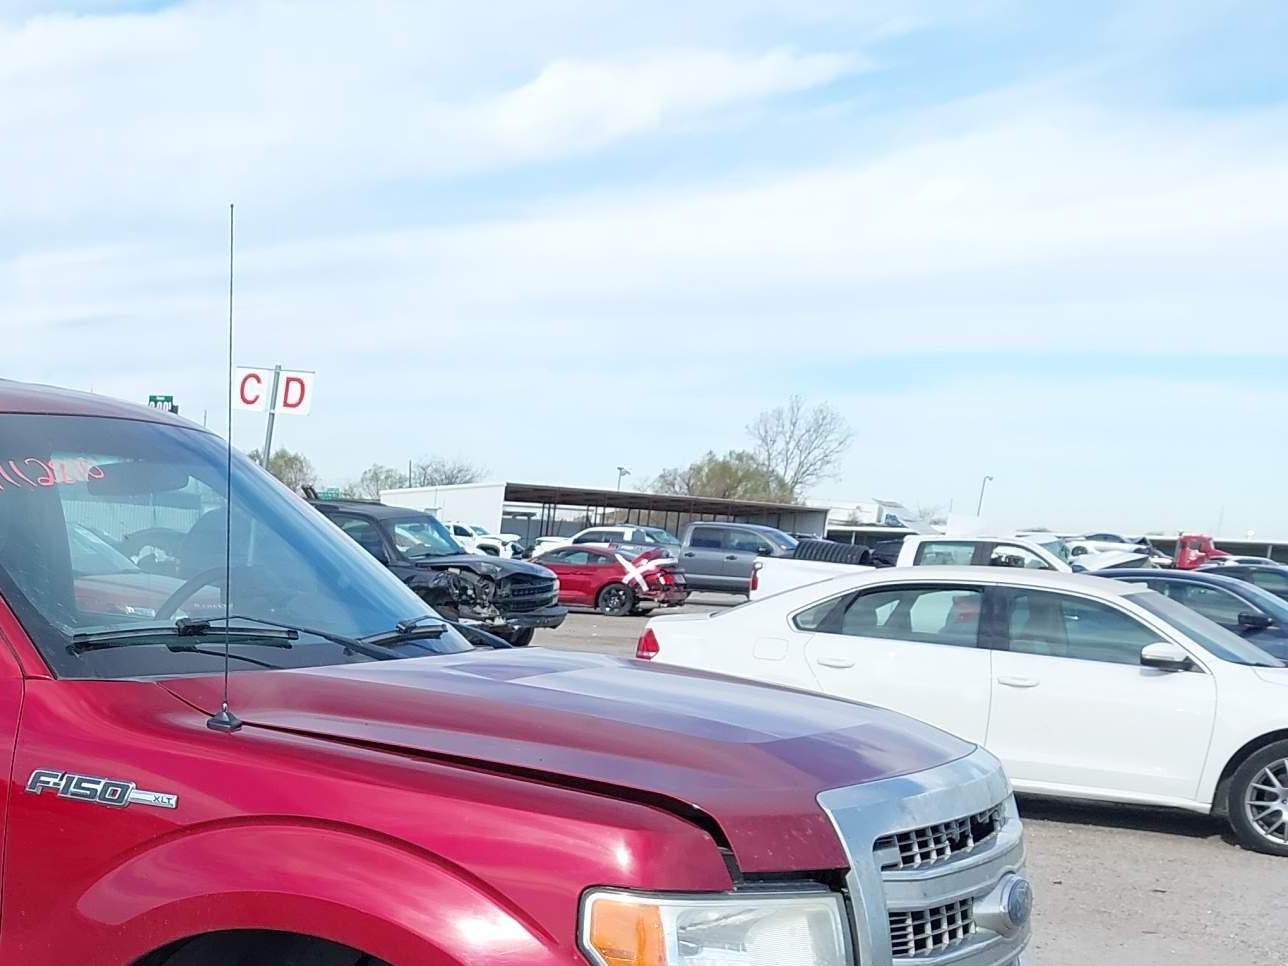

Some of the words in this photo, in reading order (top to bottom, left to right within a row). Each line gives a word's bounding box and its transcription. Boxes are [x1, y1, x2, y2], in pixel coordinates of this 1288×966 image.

[240, 373, 262, 405] C
[283, 377, 306, 409] D
[27, 768, 136, 808] F-150
[153, 794, 174, 807] XLT
